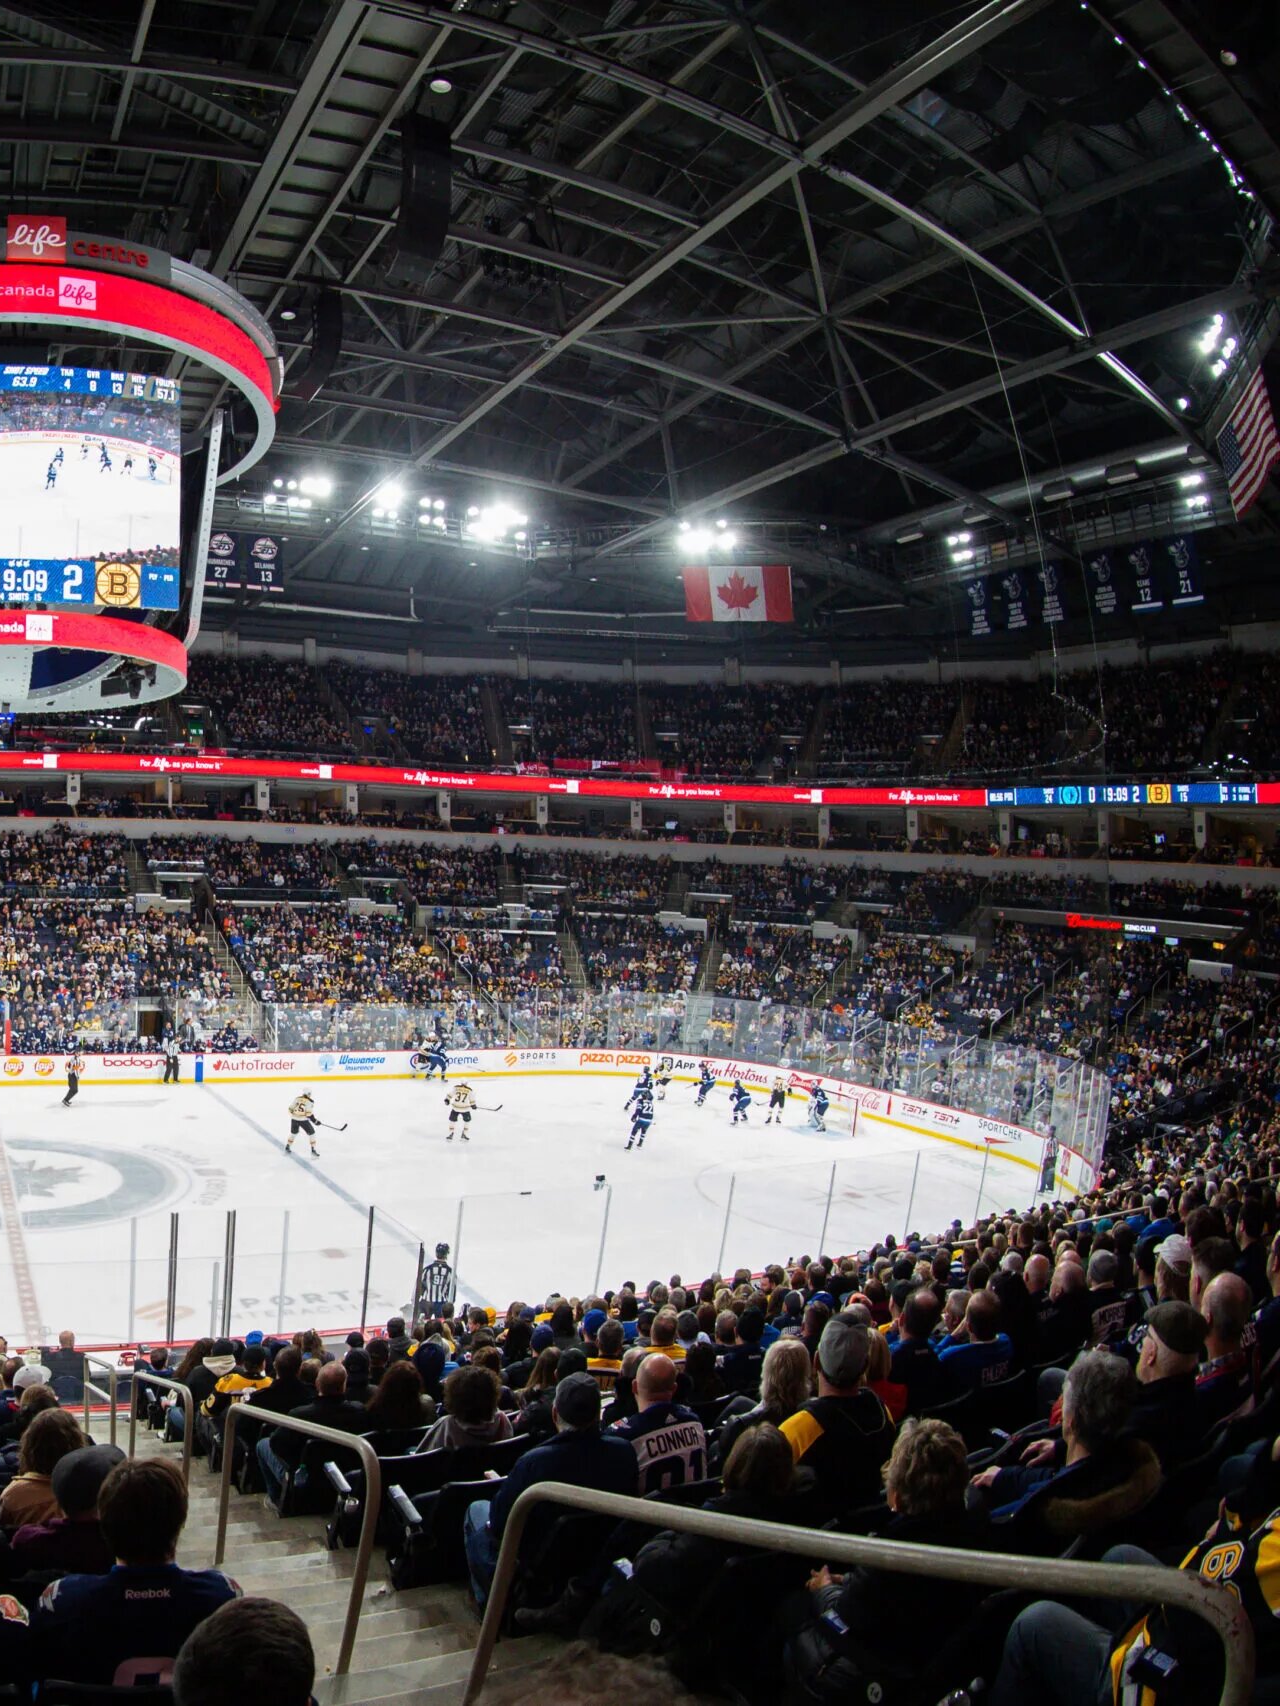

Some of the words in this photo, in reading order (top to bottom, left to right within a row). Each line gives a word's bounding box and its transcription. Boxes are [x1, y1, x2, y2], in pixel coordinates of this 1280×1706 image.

[7, 224, 66, 255] life
[73, 240, 149, 267] centre
[59, 280, 96, 305] life
[12, 376, 38, 387] 63.9
[64, 379, 71, 390] 4
[112, 383, 123, 394] 13
[133, 384, 144, 397] 15
[157, 387, 175, 400] 57.1
[214, 567, 228, 578] 27
[261, 571, 272, 582] 13
[63, 564, 83, 600] 2
[1179, 579, 1192, 594] 21
[8, 592, 30, 601] SHOTS
[34, 593, 42, 602] 15
[1139, 588, 1152, 602] 12
[140, 759, 151, 767] For
[152, 757, 171, 771] life
[182, 762, 194, 770] you
[1045, 795, 1053, 803] 24
[1088, 787, 1095, 803] 0
[1103, 787, 1127, 803] 19:09
[1133, 786, 1139, 802] 2
[1180, 792, 1188, 802] 15
[1124, 923, 1139, 931] KING
[1140, 925, 1157, 933] CLUB
[339, 1054, 385, 1065] Wawanesa
[447, 1056, 479, 1068] preme
[520, 1052, 556, 1060] SPORTS
[580, 1052, 613, 1066] pizza
[616, 1054, 651, 1067] pizza
[103, 1056, 168, 1069] bodog.n
[222, 1059, 295, 1071] AutoTrader
[723, 1062, 768, 1084] Hortons
[455, 1092, 468, 1104] 37
[642, 1102, 654, 1115] 22
[433, 1274, 444, 1286] 91
[646, 1426, 699, 1459] CONNOR
[124, 1588, 171, 1600] Reebok
